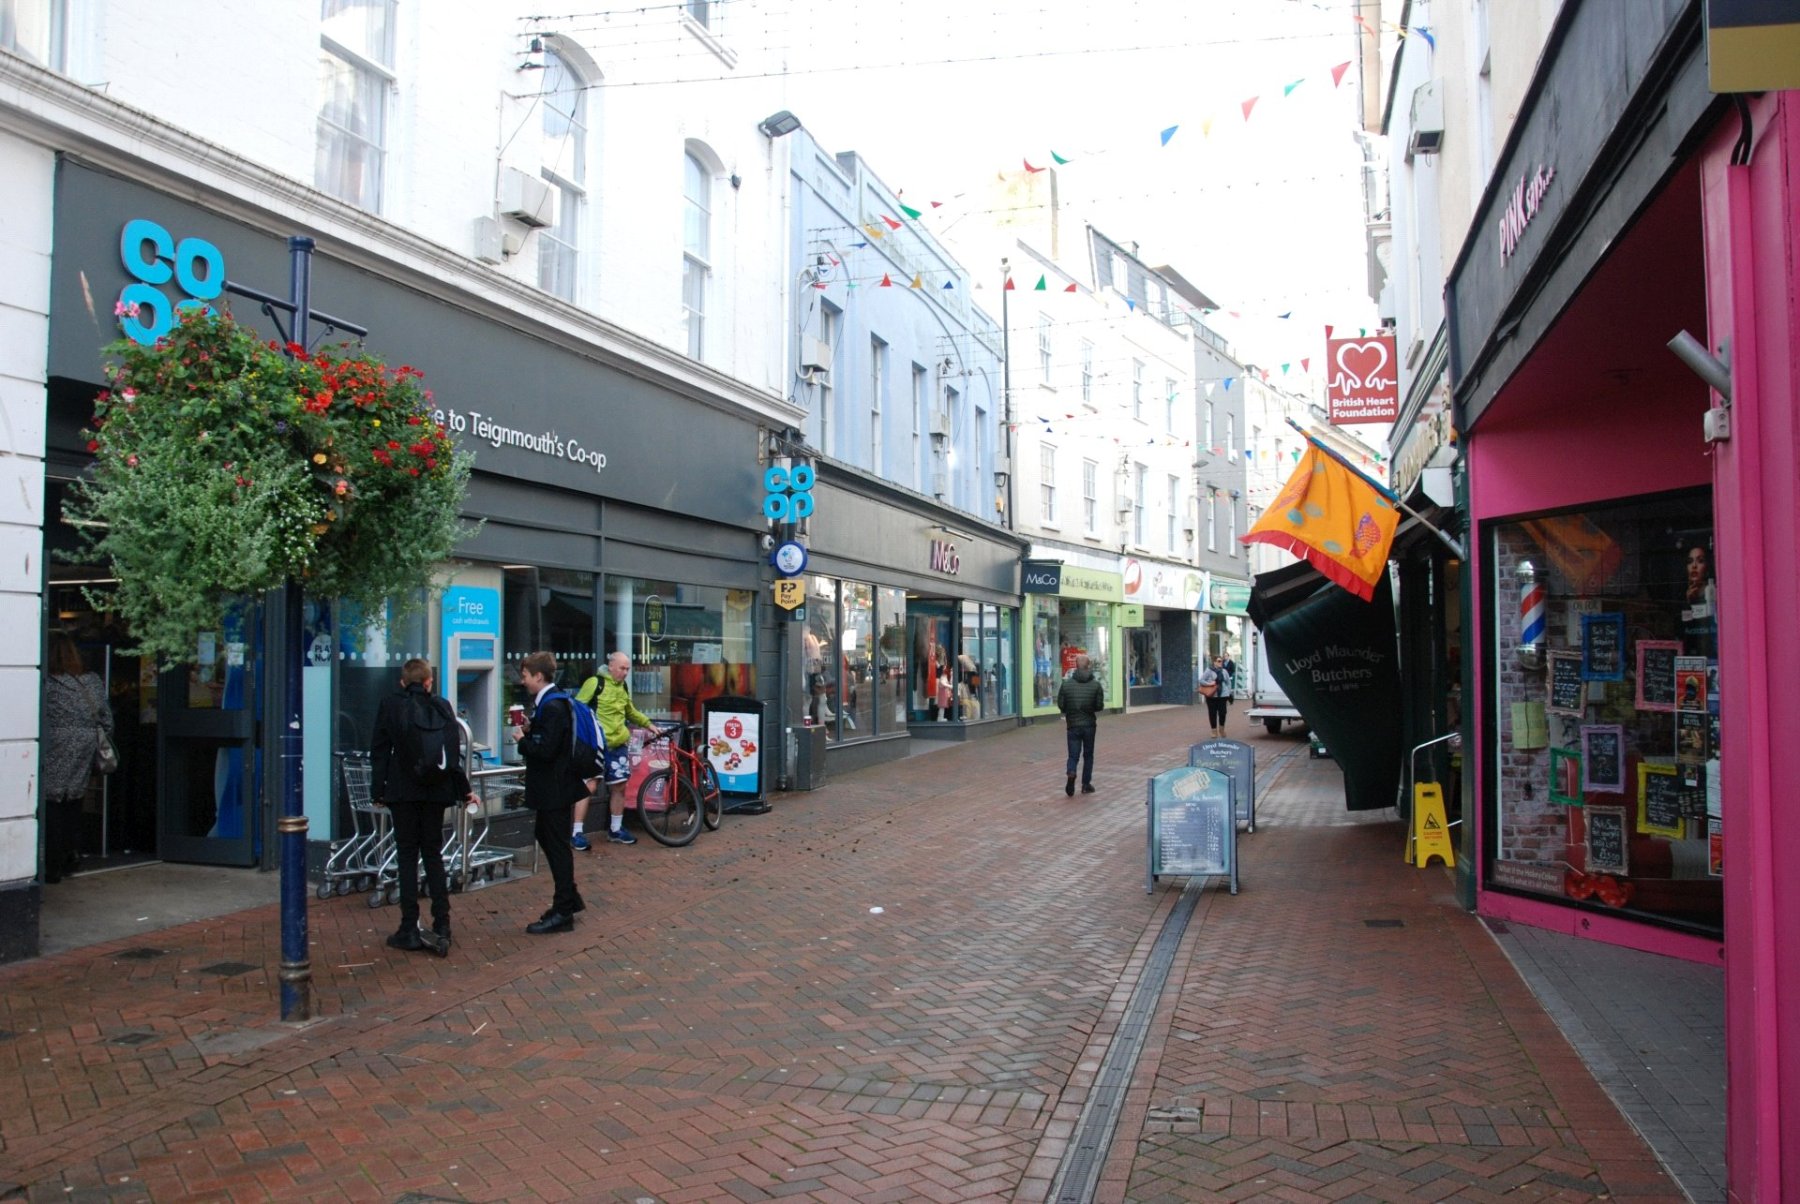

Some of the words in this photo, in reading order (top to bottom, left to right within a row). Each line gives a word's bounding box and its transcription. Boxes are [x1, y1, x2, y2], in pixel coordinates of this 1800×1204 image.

[1499, 175, 1528, 269] PINK
[1332, 397, 1364, 407] British
[1366, 396, 1394, 406] Heart
[1332, 407, 1395, 418] Foundation
[449, 408, 466, 432] to
[469, 411, 564, 458] Teignmouth's
[566, 439, 607, 473] Co-op
[931, 539, 960, 575] M&Co
[1025, 573, 1057, 586] M&Co
[458, 596, 484, 615] Free
[1285, 650, 1321, 675] Lloyd
[1325, 644, 1384, 663] Maunder
[1311, 667, 1373, 683] Butchers
[729, 727, 737, 737] 3
